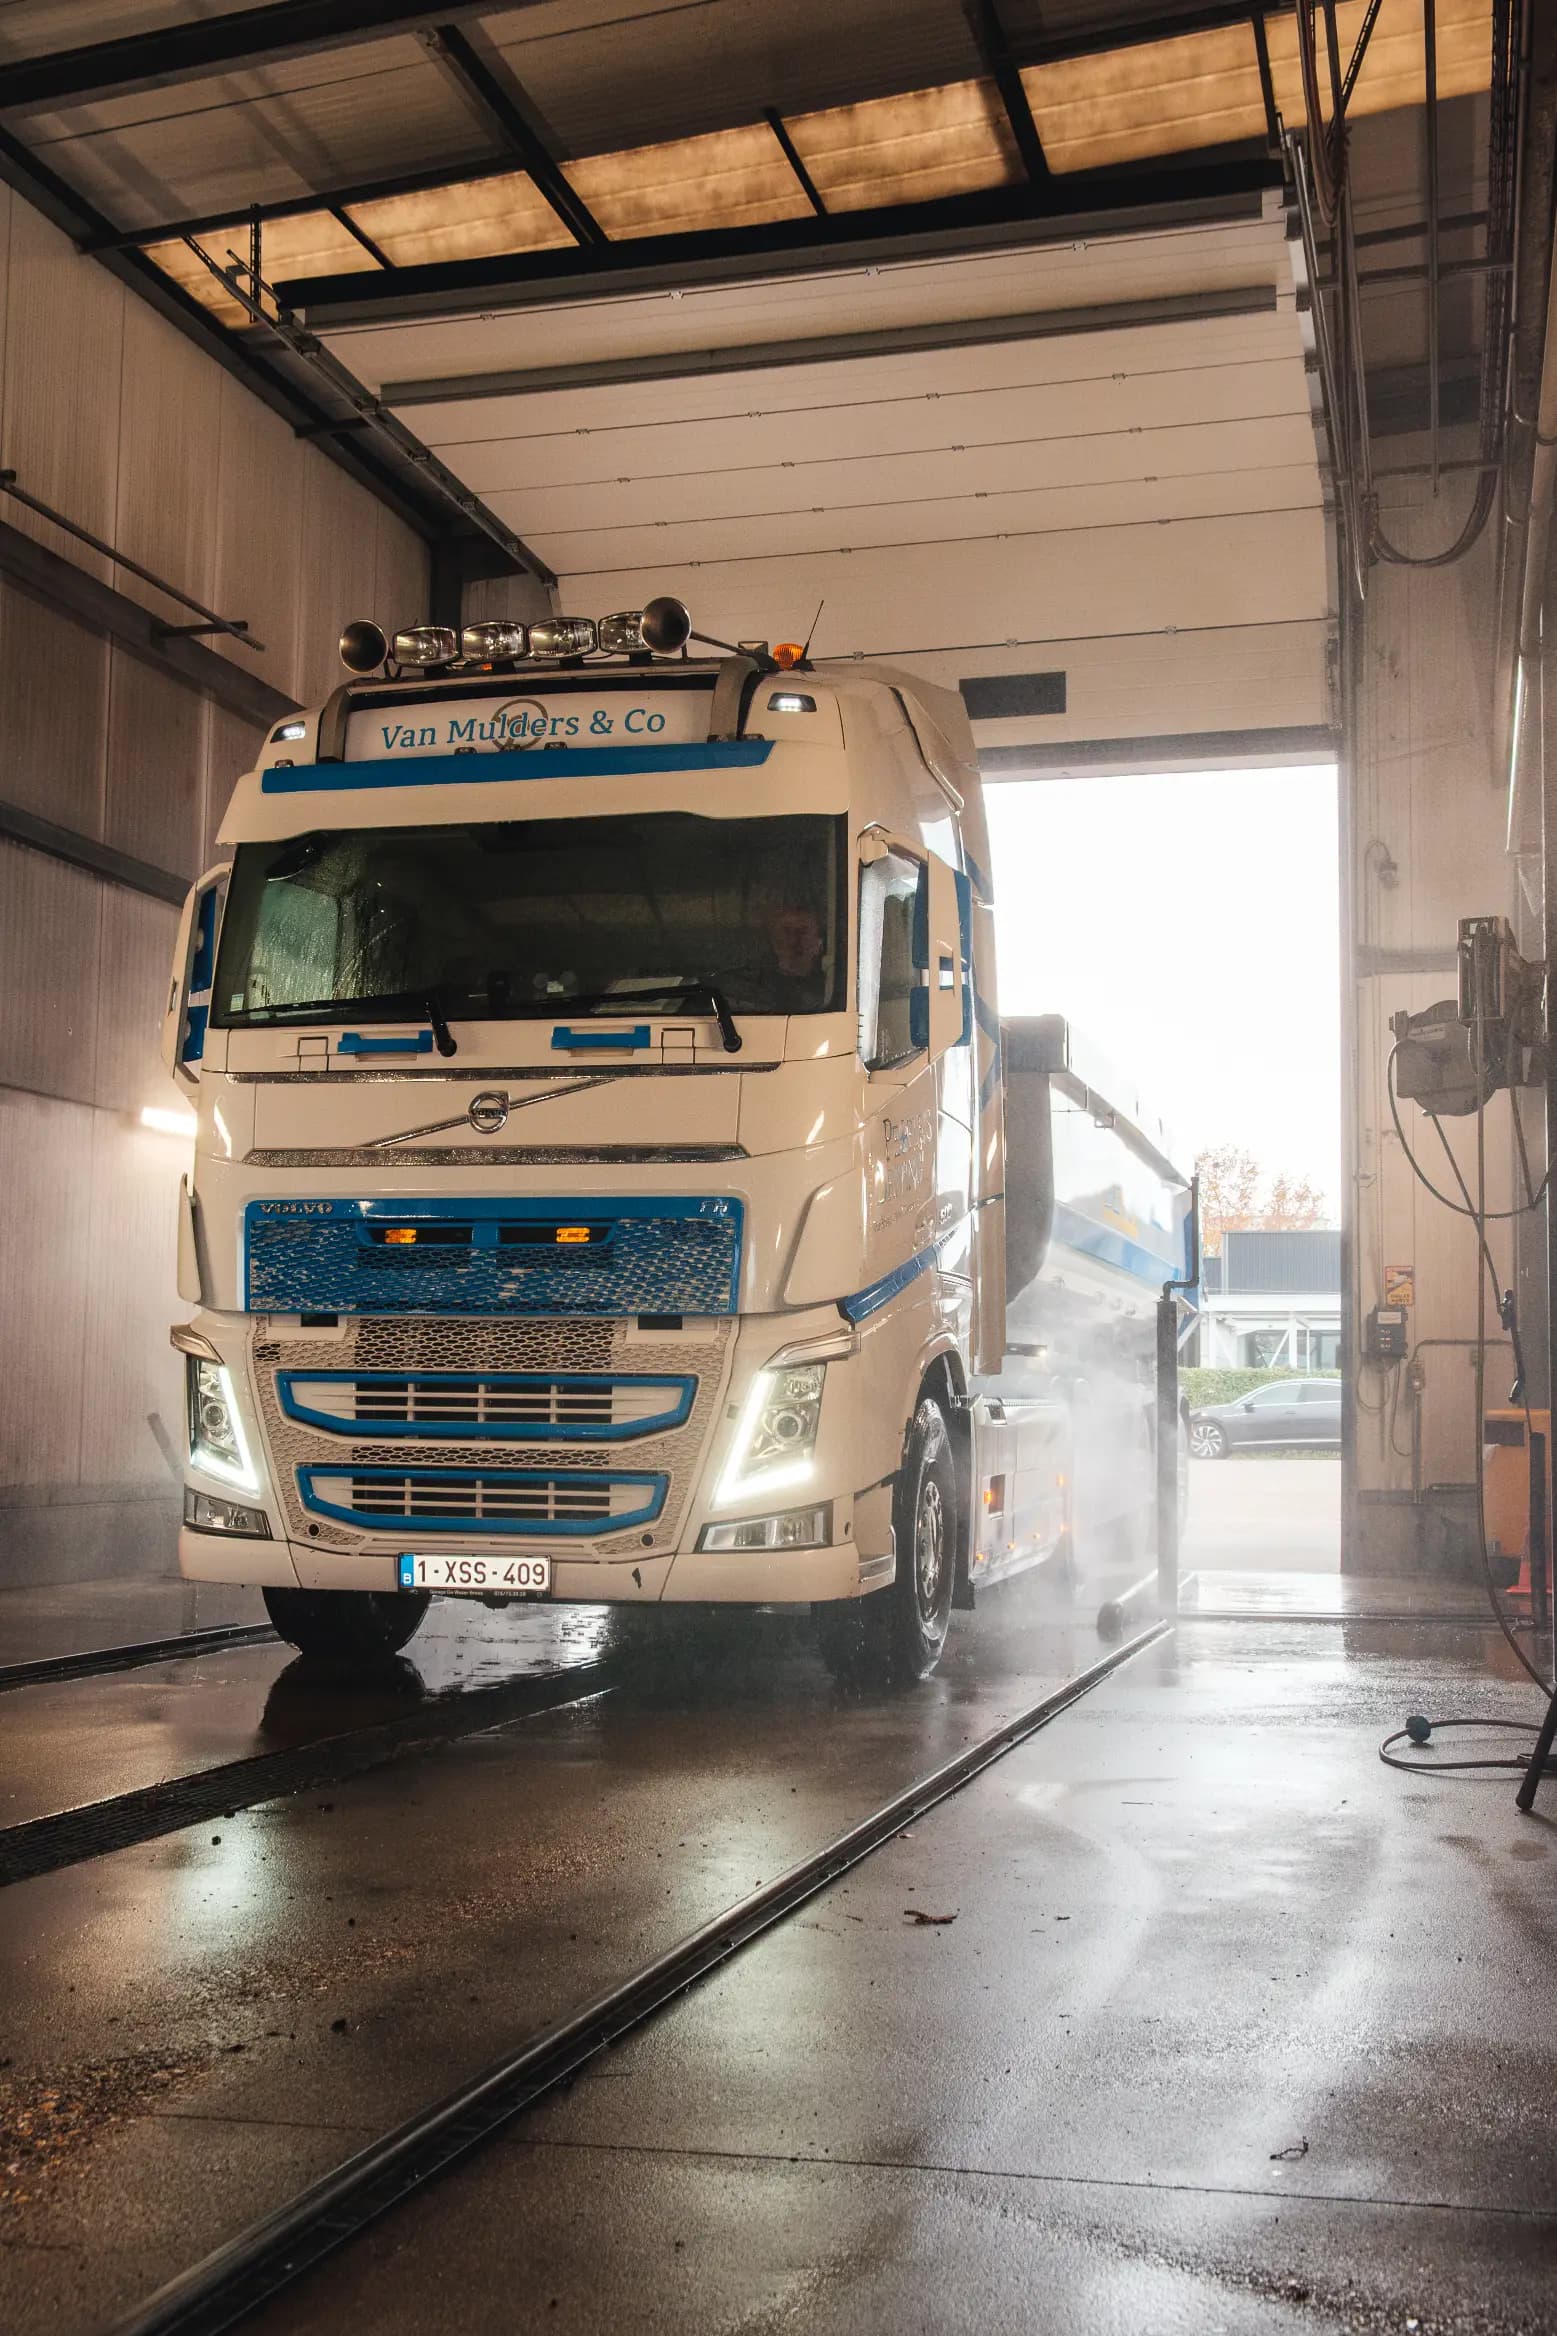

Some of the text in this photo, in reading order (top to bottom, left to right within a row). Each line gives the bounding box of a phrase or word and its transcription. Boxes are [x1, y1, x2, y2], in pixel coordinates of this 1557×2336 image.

[381, 708, 666, 750] Van Mulders & Co
[259, 1202, 333, 1214] VOLVO
[417, 1560, 545, 1586] 1-XSS-409
